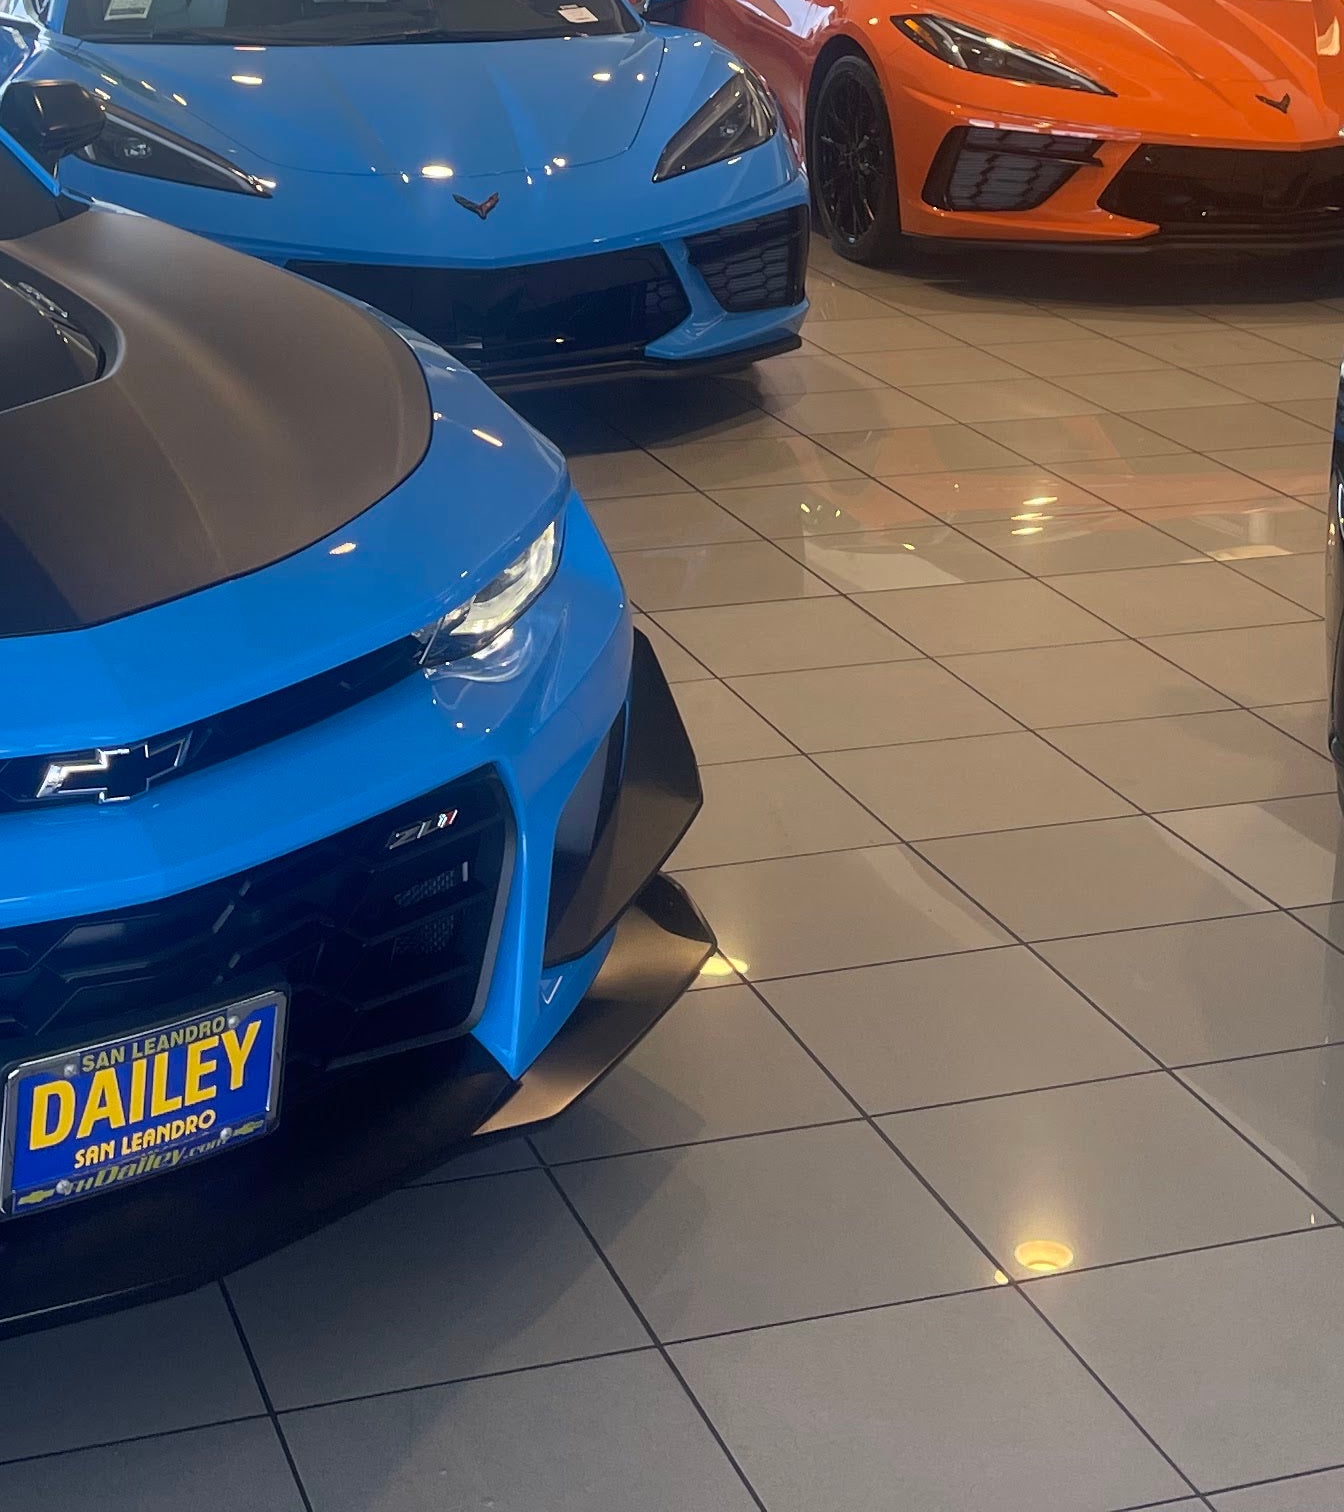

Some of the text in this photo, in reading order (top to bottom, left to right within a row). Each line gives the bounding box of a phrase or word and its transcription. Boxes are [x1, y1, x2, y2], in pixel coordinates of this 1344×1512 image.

[82, 1016, 225, 1073] SAN LEANDRO
[29, 1020, 262, 1151] DAILEY
[74, 1109, 216, 1169] SAN LEANDRO
